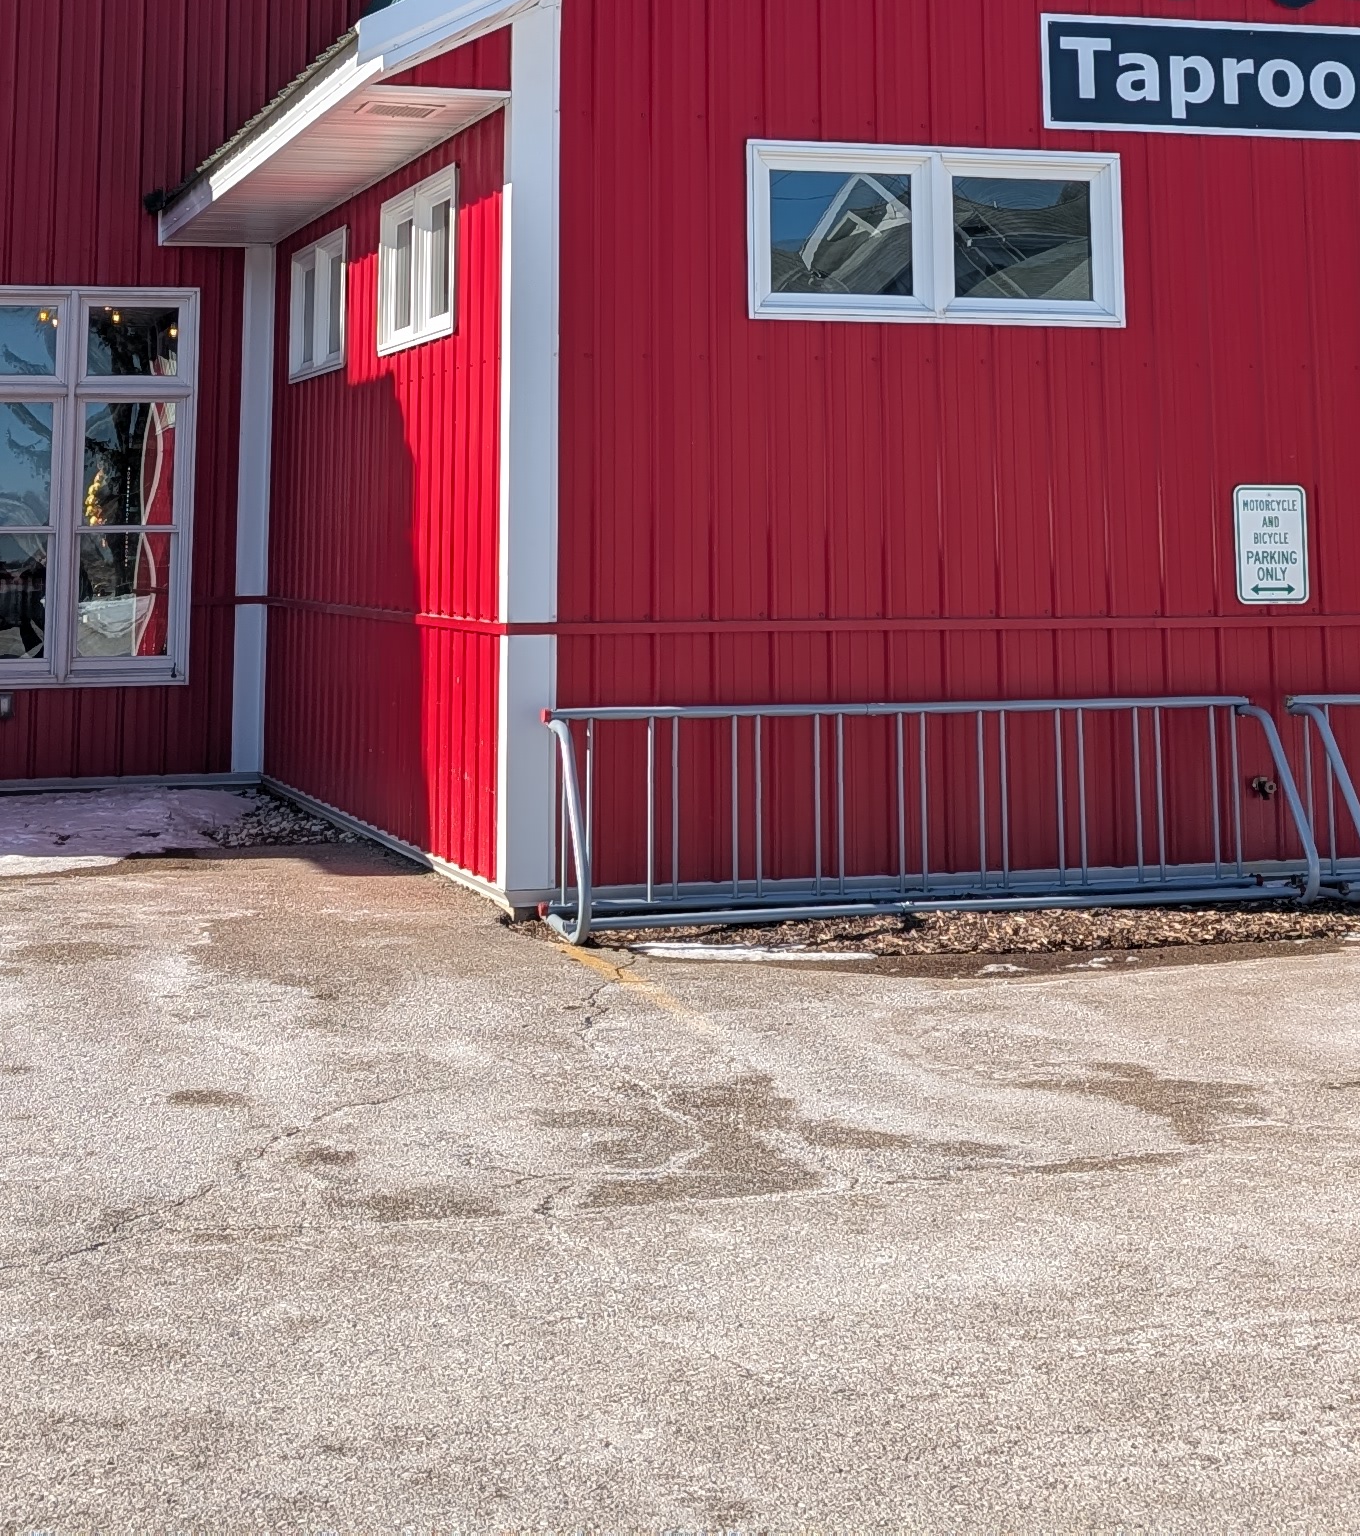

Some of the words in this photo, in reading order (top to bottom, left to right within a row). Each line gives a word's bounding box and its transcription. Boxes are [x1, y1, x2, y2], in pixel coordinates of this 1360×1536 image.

[1242, 499, 1298, 512] MOTORCYCLE
[1261, 516, 1280, 528] AND
[1253, 532, 1289, 545] BICYCLE
[1246, 550, 1298, 565] PARKING
[1256, 566, 1288, 582] ONLY
